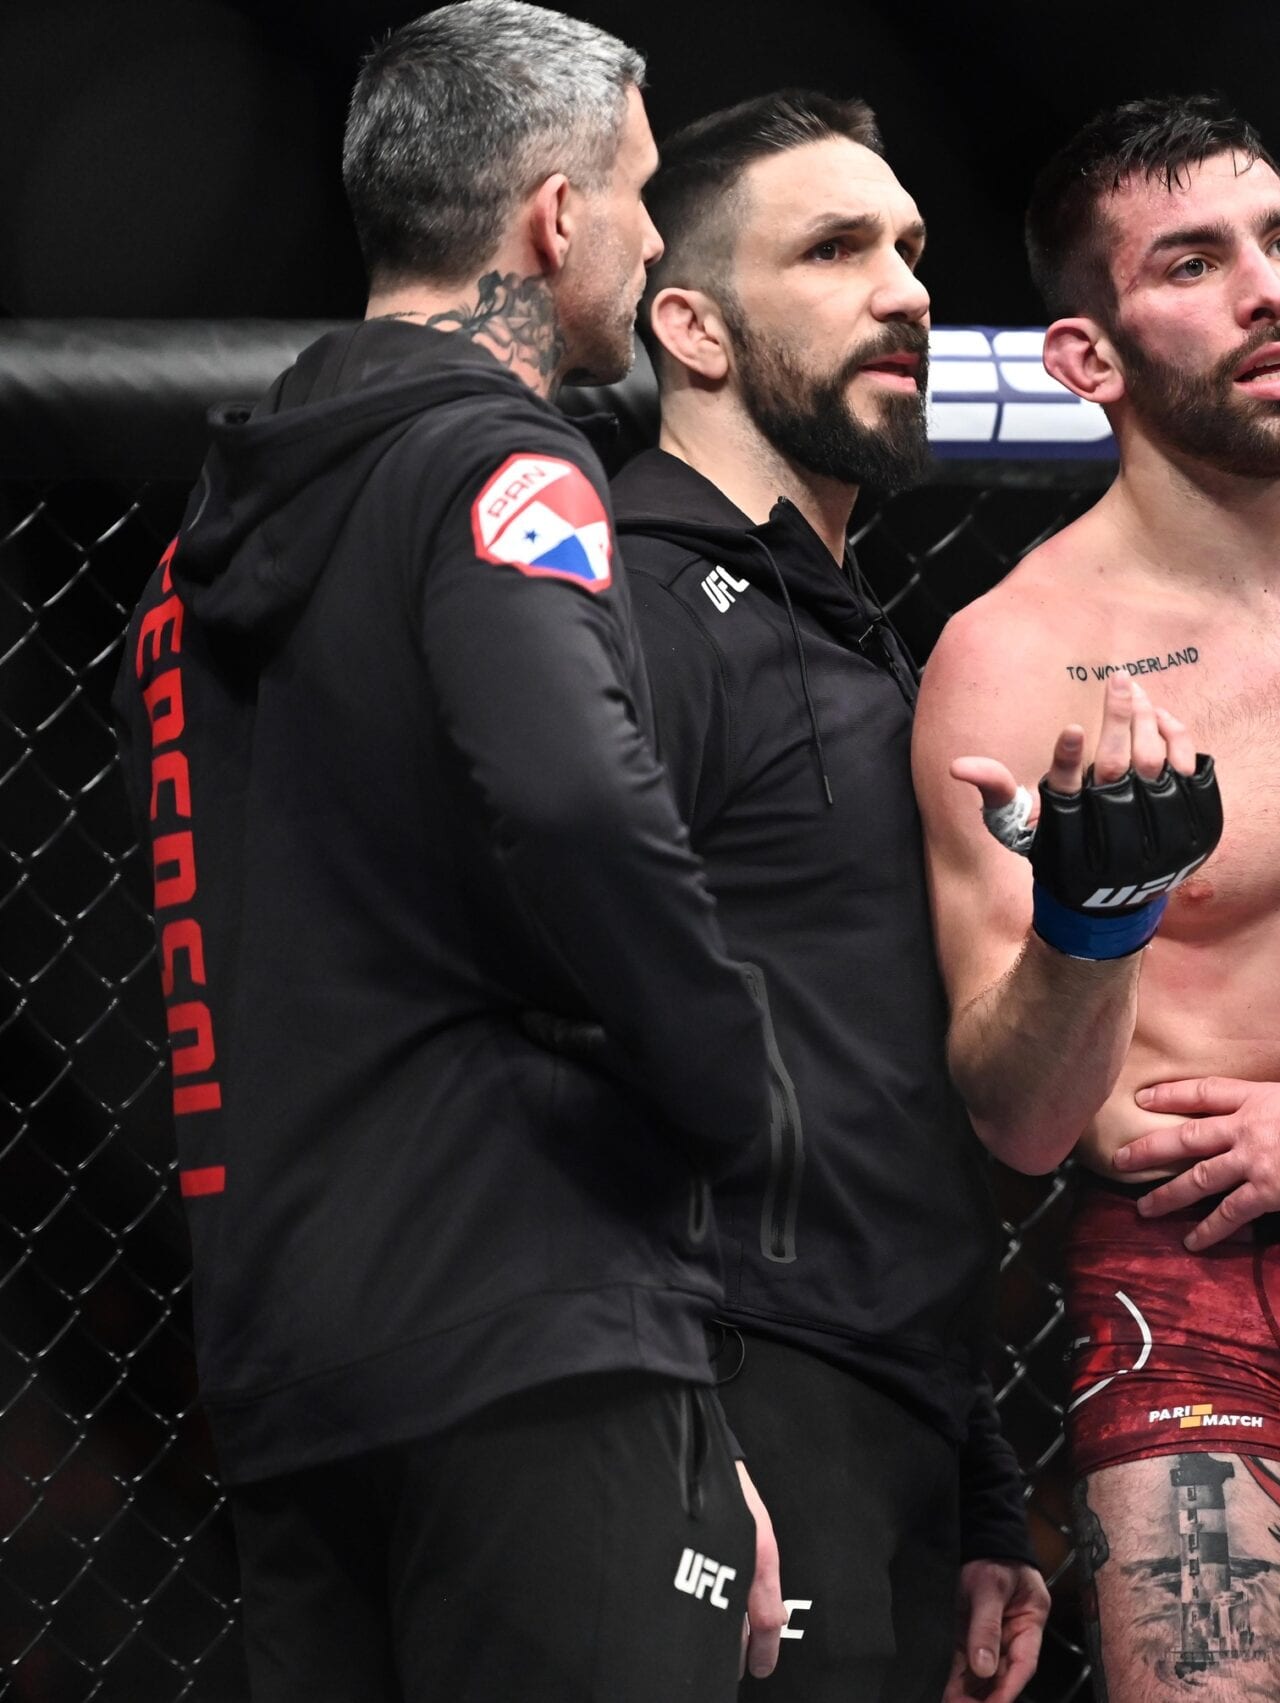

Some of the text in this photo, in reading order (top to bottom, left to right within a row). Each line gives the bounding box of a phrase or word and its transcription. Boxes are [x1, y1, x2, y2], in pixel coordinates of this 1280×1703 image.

[487, 465, 546, 518] PAN
[701, 565, 750, 613] UFC
[1066, 647, 1199, 681] TO WODERLAND
[1148, 1405, 1263, 1428] PARI MATCH
[674, 1547, 736, 1610] UFC
